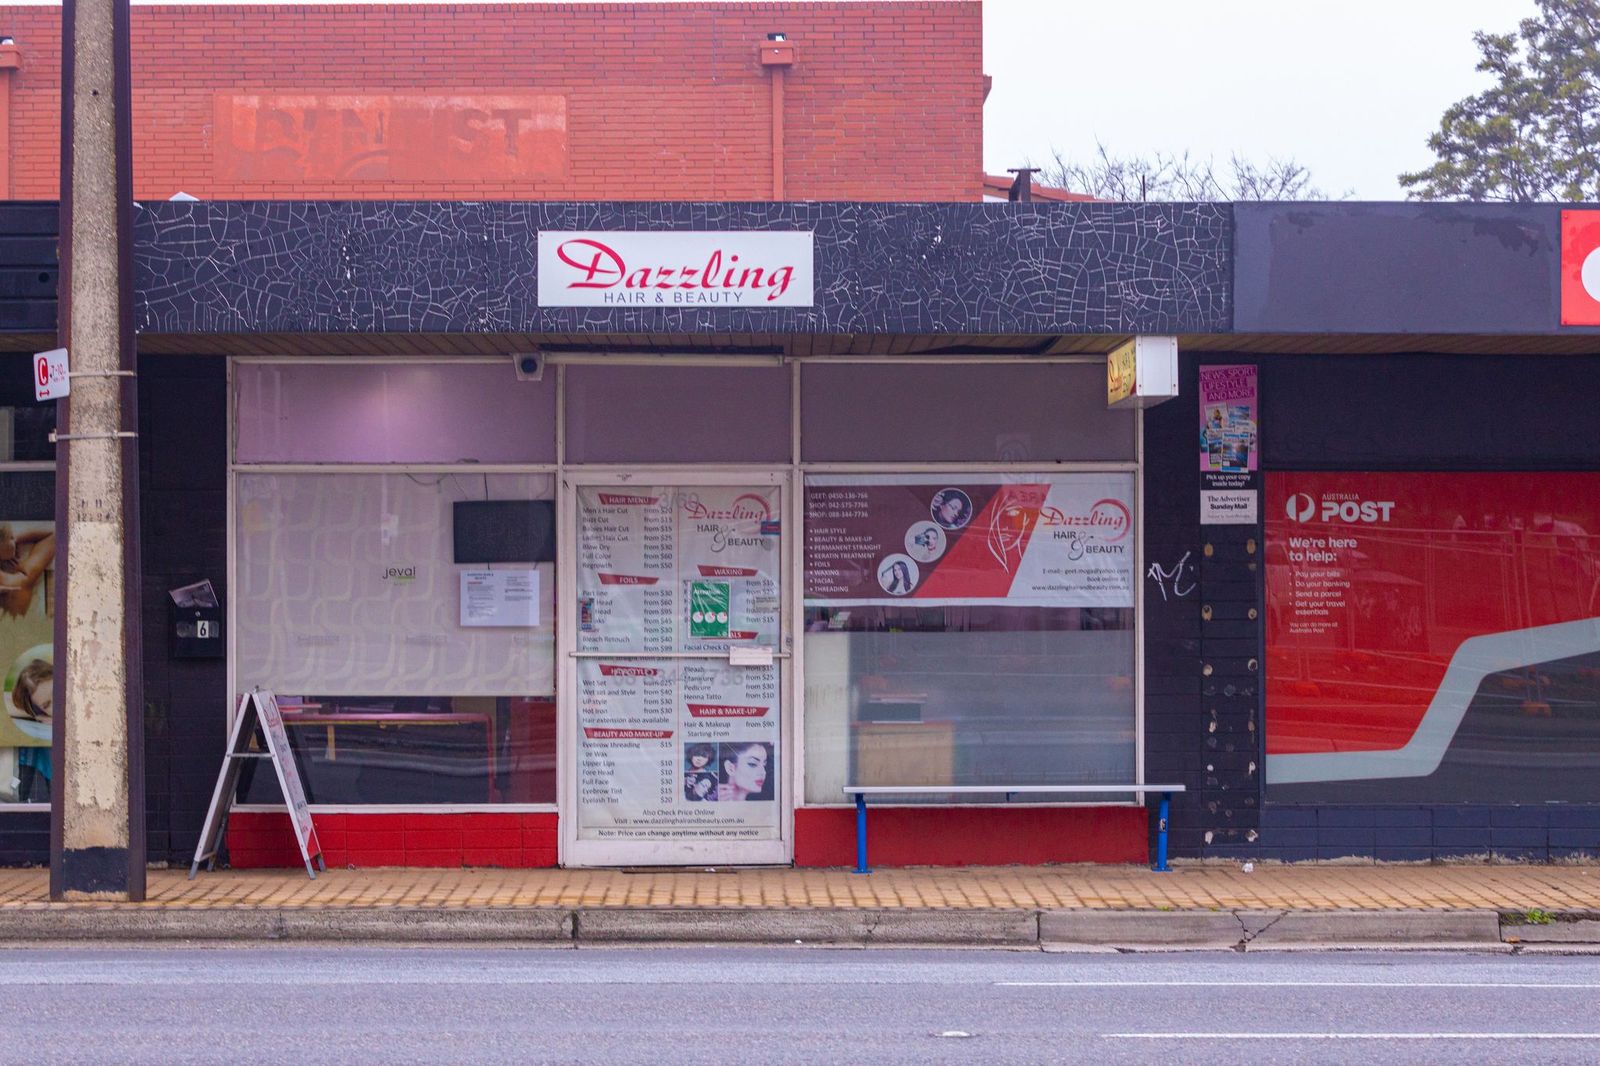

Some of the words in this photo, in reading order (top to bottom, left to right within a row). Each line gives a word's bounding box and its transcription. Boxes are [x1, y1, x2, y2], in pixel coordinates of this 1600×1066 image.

[556, 238, 797, 301] Dazzling
[603, 291, 646, 303] HAIR
[655, 291, 664, 303] &
[673, 291, 743, 303] BEAUTY
[1212, 480, 1228, 488] inside
[684, 500, 764, 524] Dazzling
[1210, 503, 1233, 511] Sunday
[1321, 501, 1396, 523] POST
[1039, 506, 1124, 530] Dazzling
[697, 524, 719, 532] HAIR
[1053, 531, 1077, 539] HAIR
[727, 538, 765, 546] BEAUTY
[1289, 537, 1326, 548] We're
[1328, 537, 1358, 548] here
[1085, 545, 1125, 554] BEAUTY
[1289, 551, 1303, 562] to
[1306, 551, 1337, 563] help:
[382, 565, 416, 580] jeval
[200, 622, 207, 637] 6
